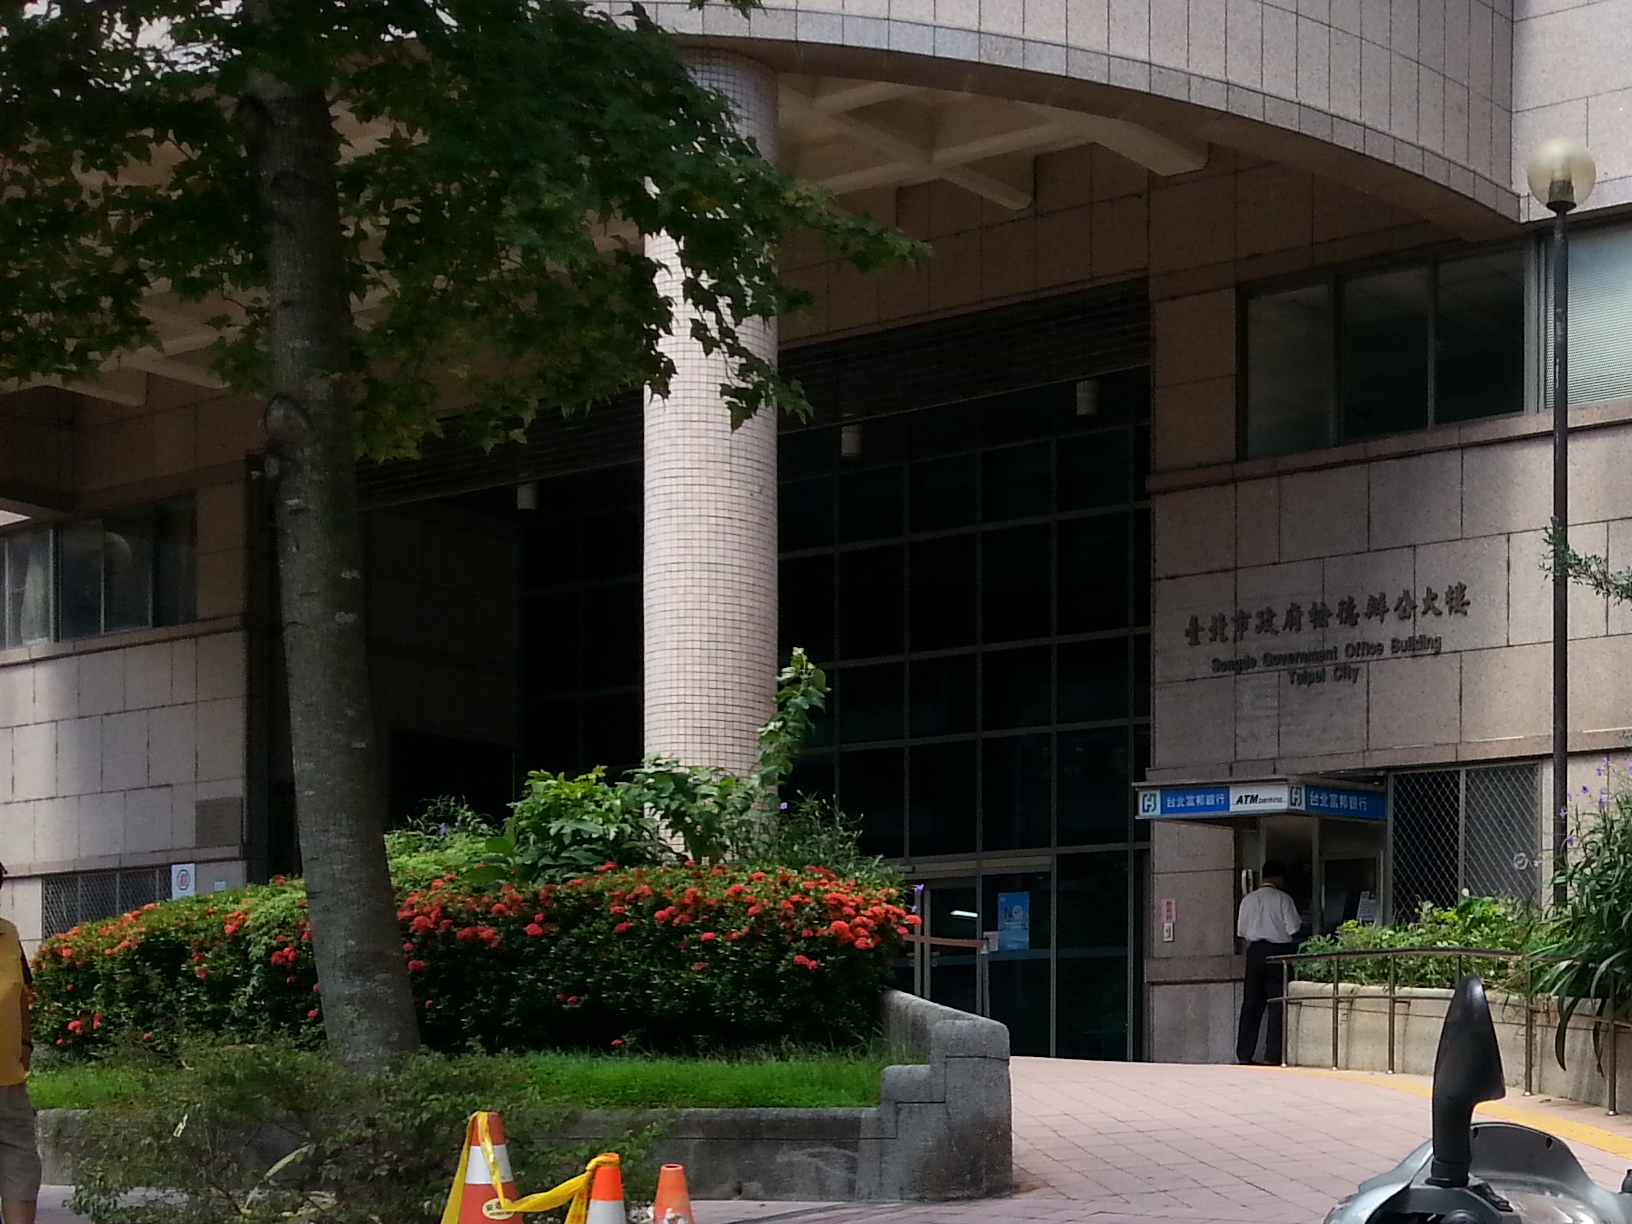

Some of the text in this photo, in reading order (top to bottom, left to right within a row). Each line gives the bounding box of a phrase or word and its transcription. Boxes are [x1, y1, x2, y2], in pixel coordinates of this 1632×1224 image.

[1262, 645, 1338, 667] Government
[1345, 641, 1384, 658] Office
[1391, 634, 1442, 654] Building
[1287, 664, 1360, 687] Taipei City
[1166, 793, 1225, 808] 台北富邦銀行
[1235, 795, 1259, 805] ATM
[1309, 791, 1367, 811] 台北富邦銀行
